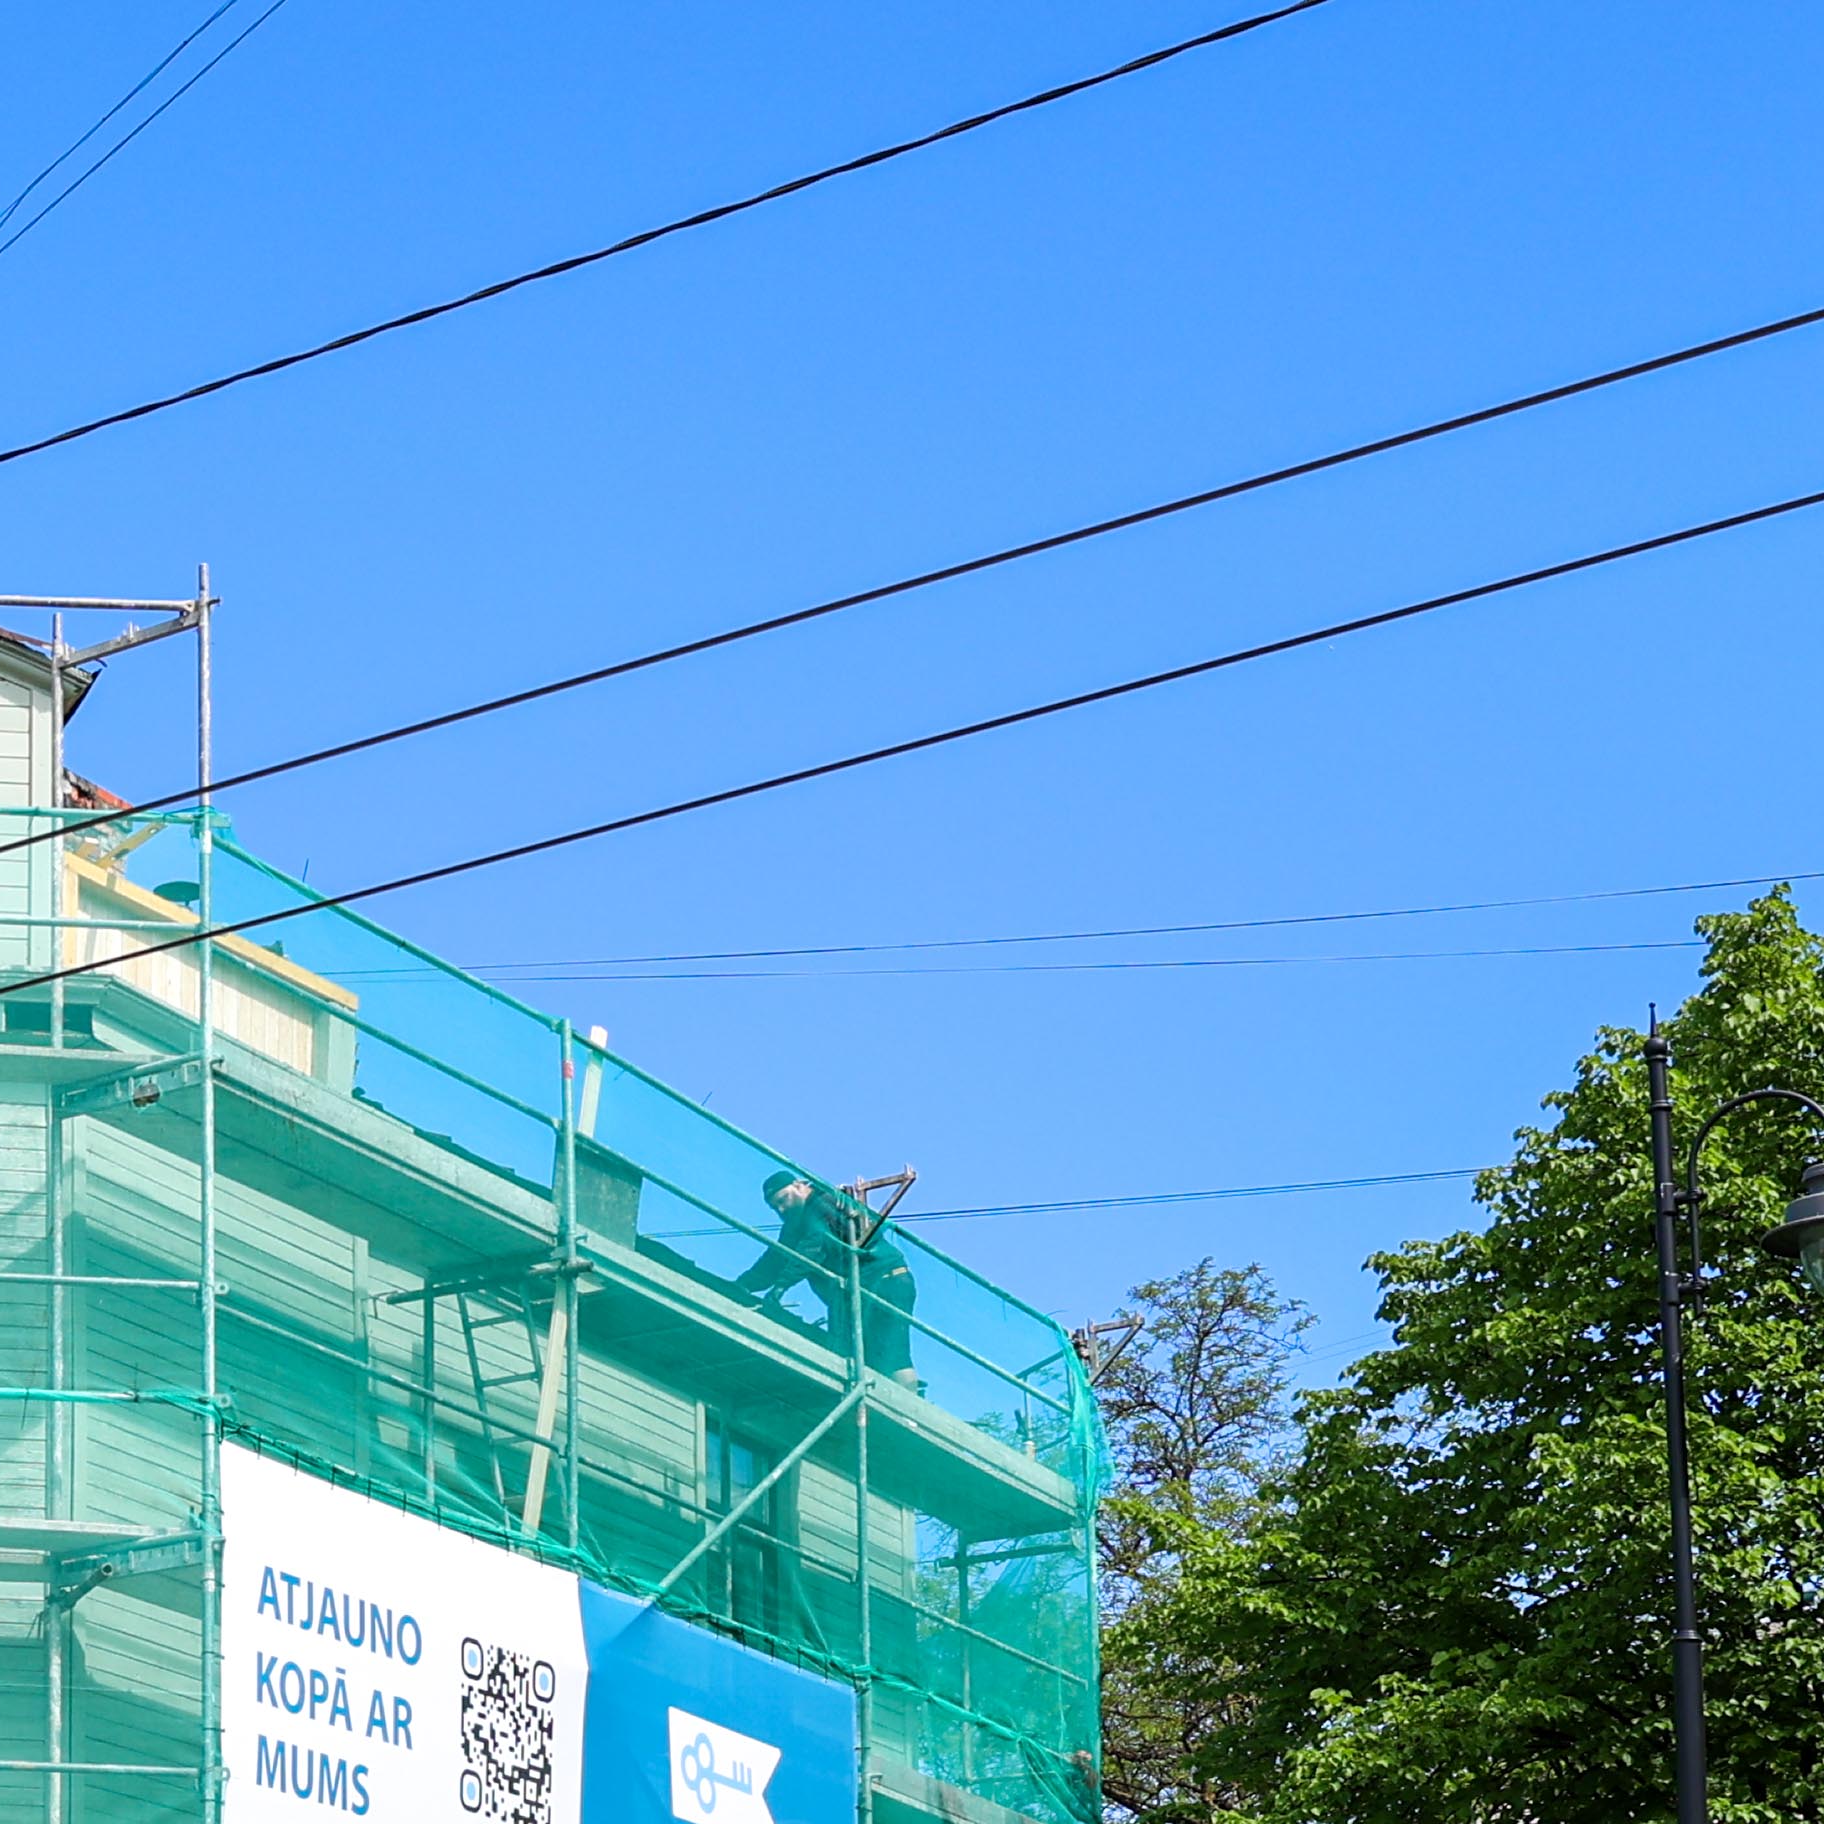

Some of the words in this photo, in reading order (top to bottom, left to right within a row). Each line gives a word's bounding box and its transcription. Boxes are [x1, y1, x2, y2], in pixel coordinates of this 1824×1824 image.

[257, 1565, 423, 1666] ATJAUNO
[256, 1650, 353, 1731] KOPĀ
[366, 1689, 413, 1750] AR
[256, 1734, 370, 1816] MUMS
